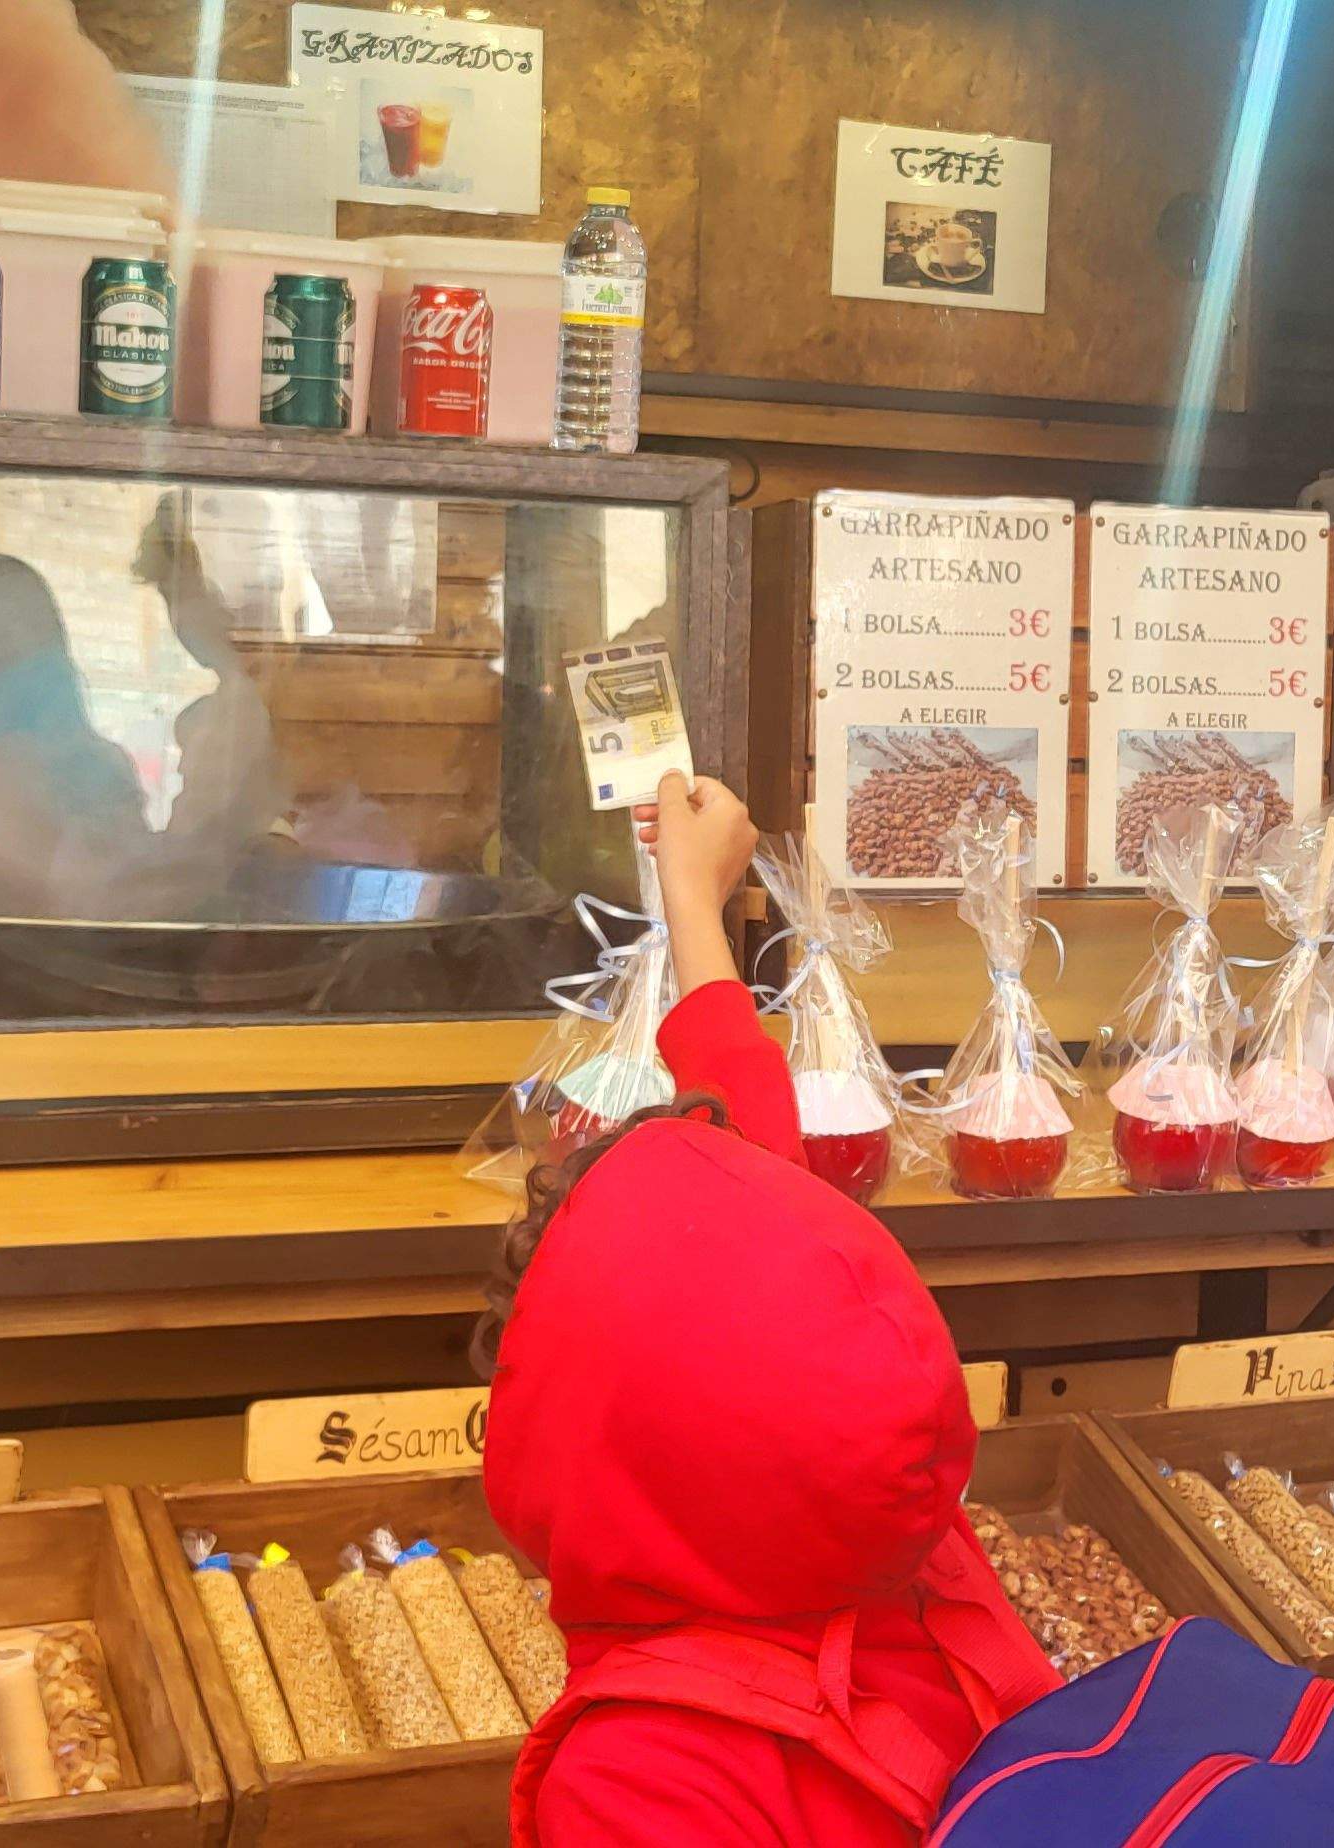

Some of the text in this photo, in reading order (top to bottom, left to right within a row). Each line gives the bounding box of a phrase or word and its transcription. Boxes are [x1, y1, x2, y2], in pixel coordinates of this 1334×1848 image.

[300, 29, 535, 75] GRANIZADOS
[890, 147, 1005, 187] CAFÉ
[94, 325, 169, 351] Mahou
[840, 510, 1049, 541] GARRAPIÑADO
[1112, 521, 1307, 552] GARRAPIÑADO
[868, 557, 1022, 585] ARTESANO
[1138, 566, 1281, 593] ARTESANO
[1008, 608, 1050, 638] 3€
[1112, 615, 1123, 641] 1
[1268, 616, 1308, 645] 3€
[835, 662, 853, 688] 2
[1008, 661, 1051, 692] 5€
[1106, 668, 1123, 693] 2
[1268, 668, 1308, 697] 5€
[899, 708, 987, 725] A ELEGIR
[1166, 712, 1248, 729] A ELEGIR
[588, 731, 624, 754] 5
